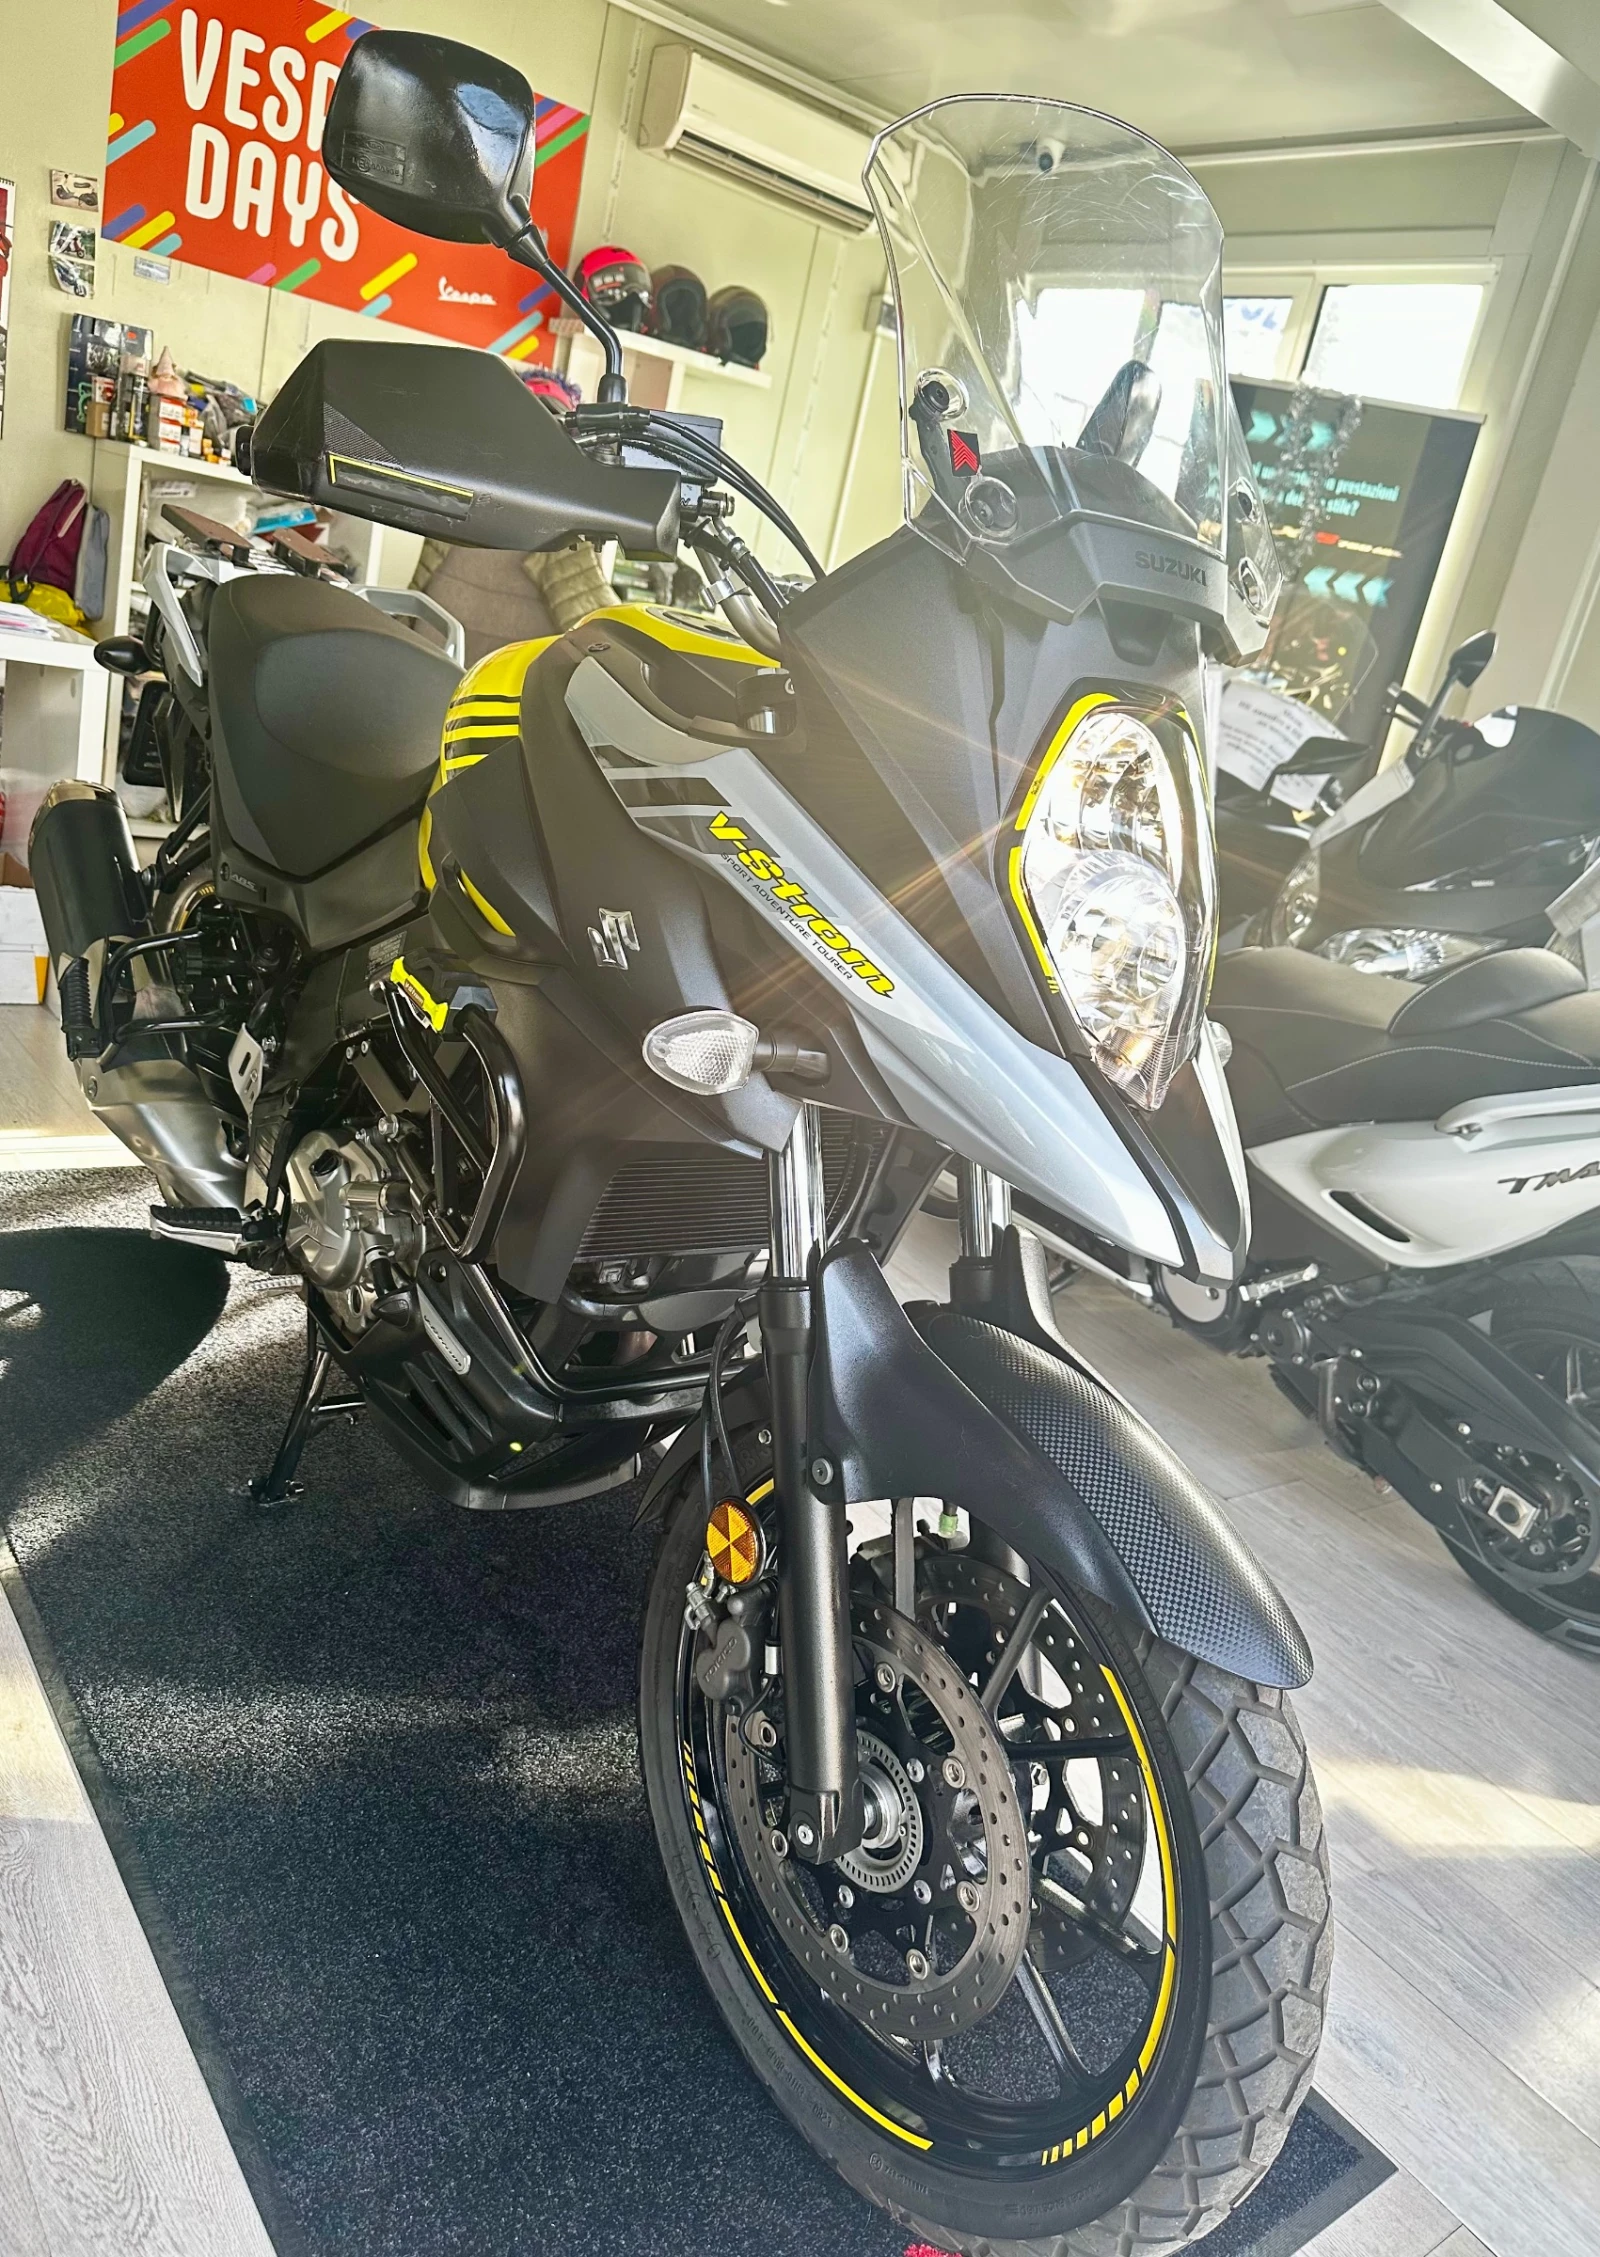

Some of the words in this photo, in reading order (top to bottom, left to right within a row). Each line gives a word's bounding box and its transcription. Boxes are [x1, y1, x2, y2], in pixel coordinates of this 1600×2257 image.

[181, 8, 341, 152] VESP
[185, 122, 360, 262] DAYS
[1335, 479, 1400, 502] prestazioni
[1134, 550, 1208, 587] SUZUKI
[720, 851, 754, 884] SPORT
[752, 883, 811, 940] ADVENTURE
[811, 938, 853, 980] TOURER
[1497, 1160, 1600, 1194] TMA
